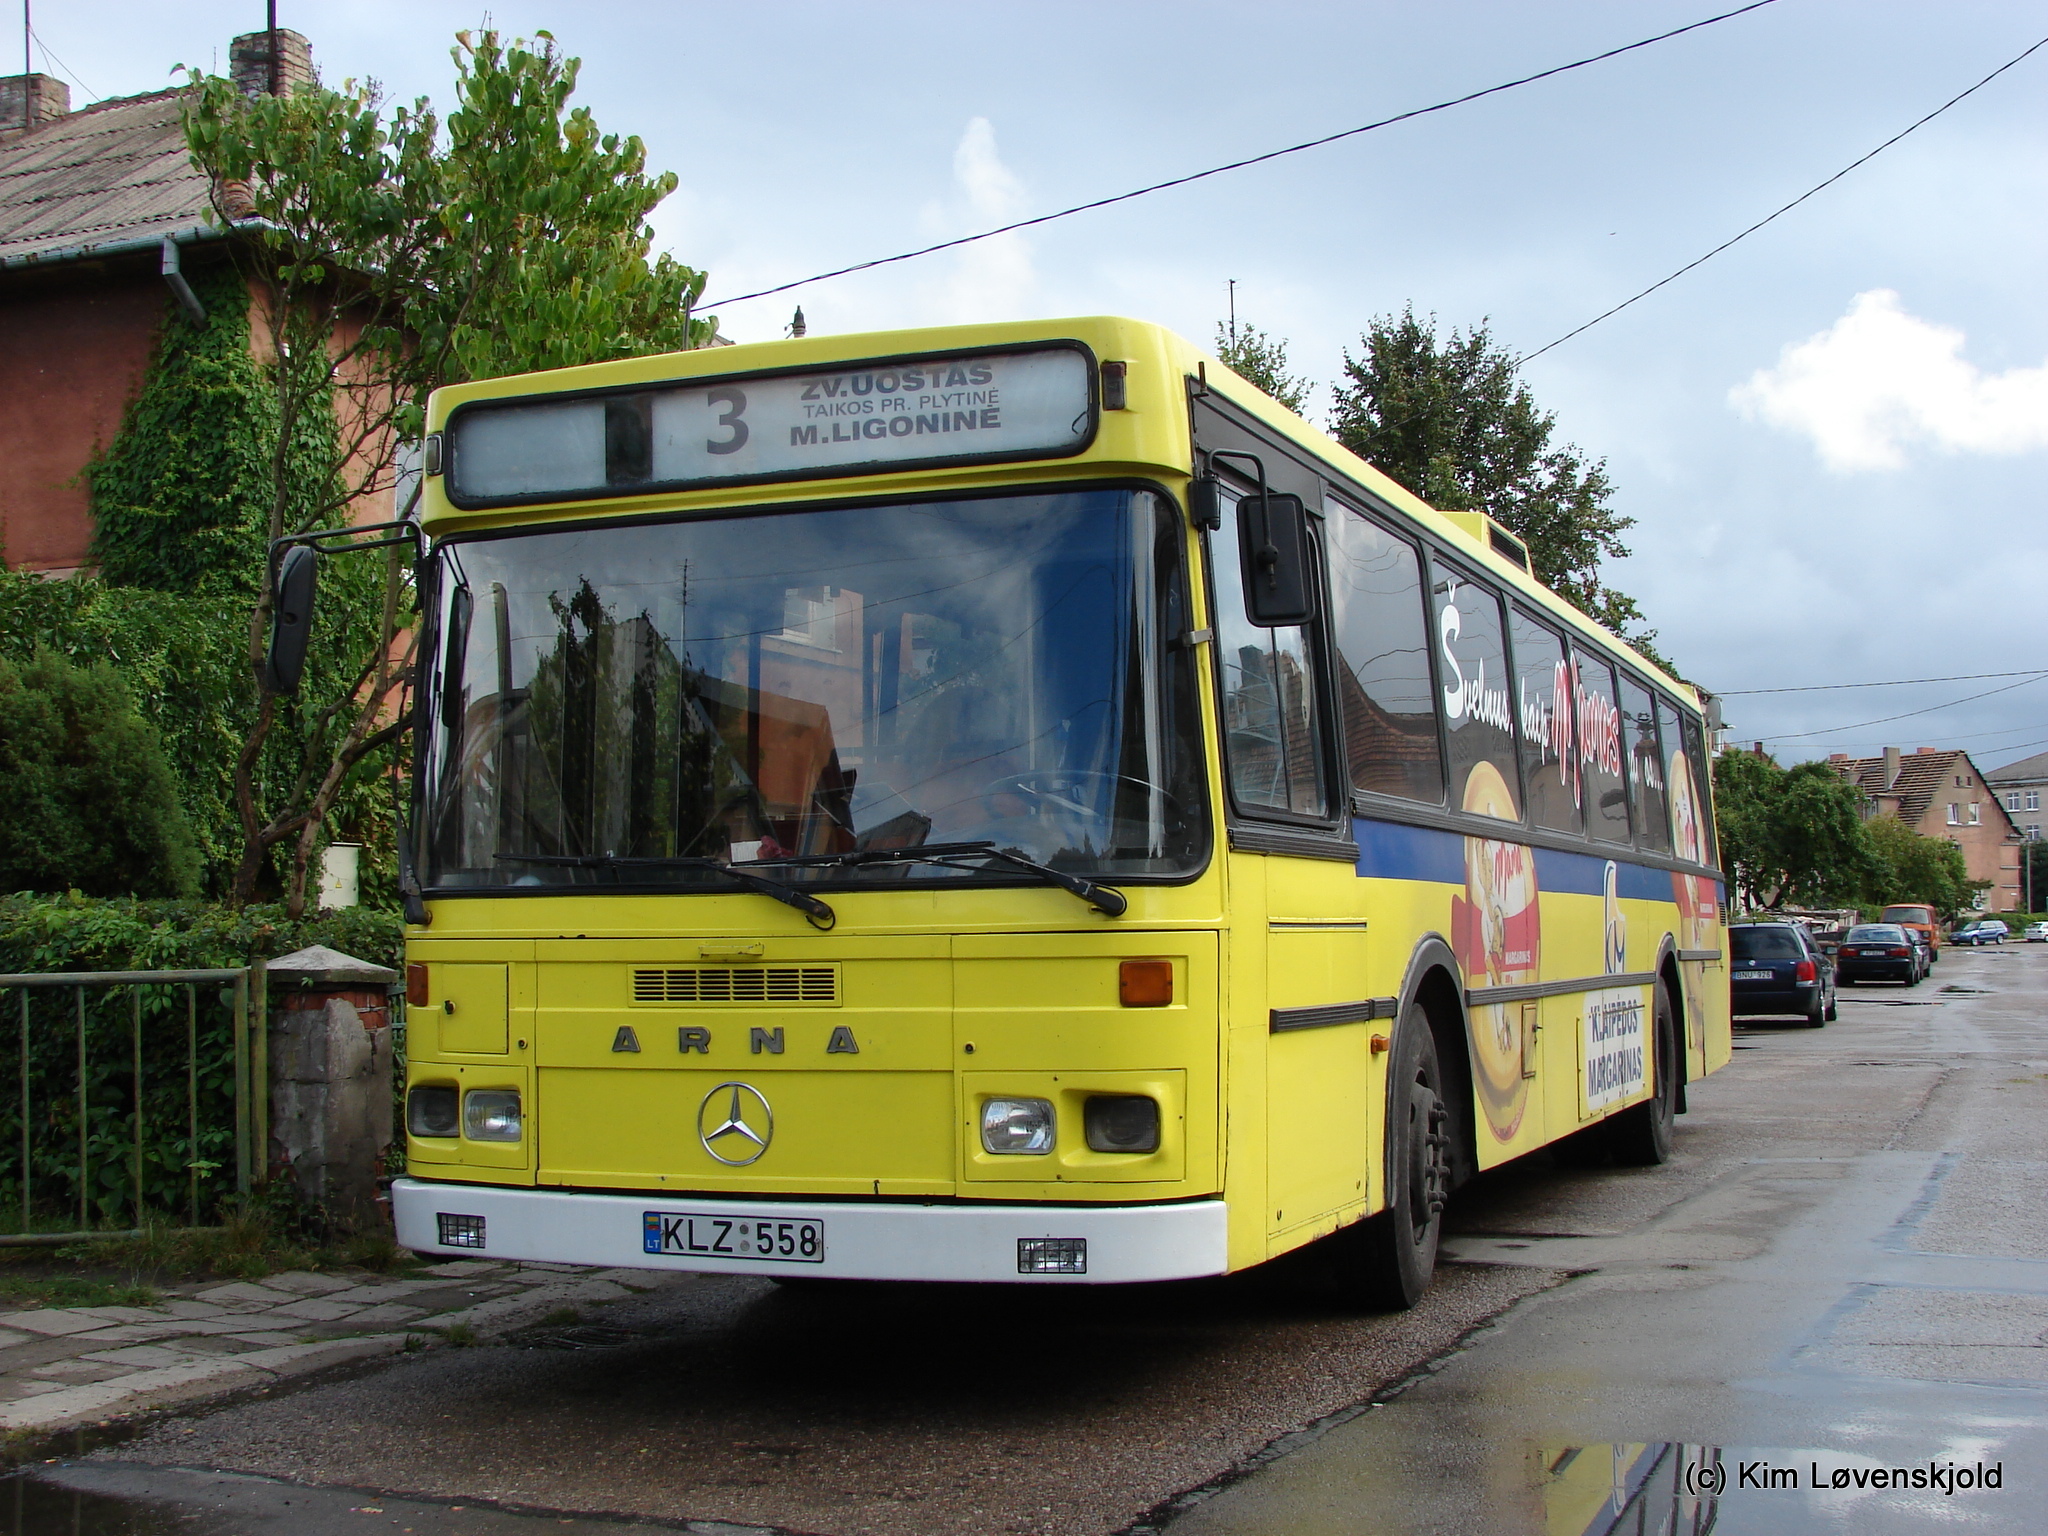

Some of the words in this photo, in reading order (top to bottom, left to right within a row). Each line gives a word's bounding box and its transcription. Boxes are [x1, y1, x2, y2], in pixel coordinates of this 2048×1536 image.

[706, 387, 749, 455] 3
[803, 400, 874, 419] TAIKOS
[881, 396, 911, 413] PR.
[919, 387, 1000, 409] PLYTINĖ
[790, 404, 1001, 447] M.LIGONINĖ
[1441, 580, 1514, 739] Švelnus,
[1521, 676, 1550, 766] kaip
[611, 1025, 860, 1055] ARNA
[1587, 1045, 1643, 1098] MARGARINAS
[647, 1239, 660, 1249] LT
[663, 1217, 734, 1253] KLZ
[755, 1222, 817, 1257] 558
